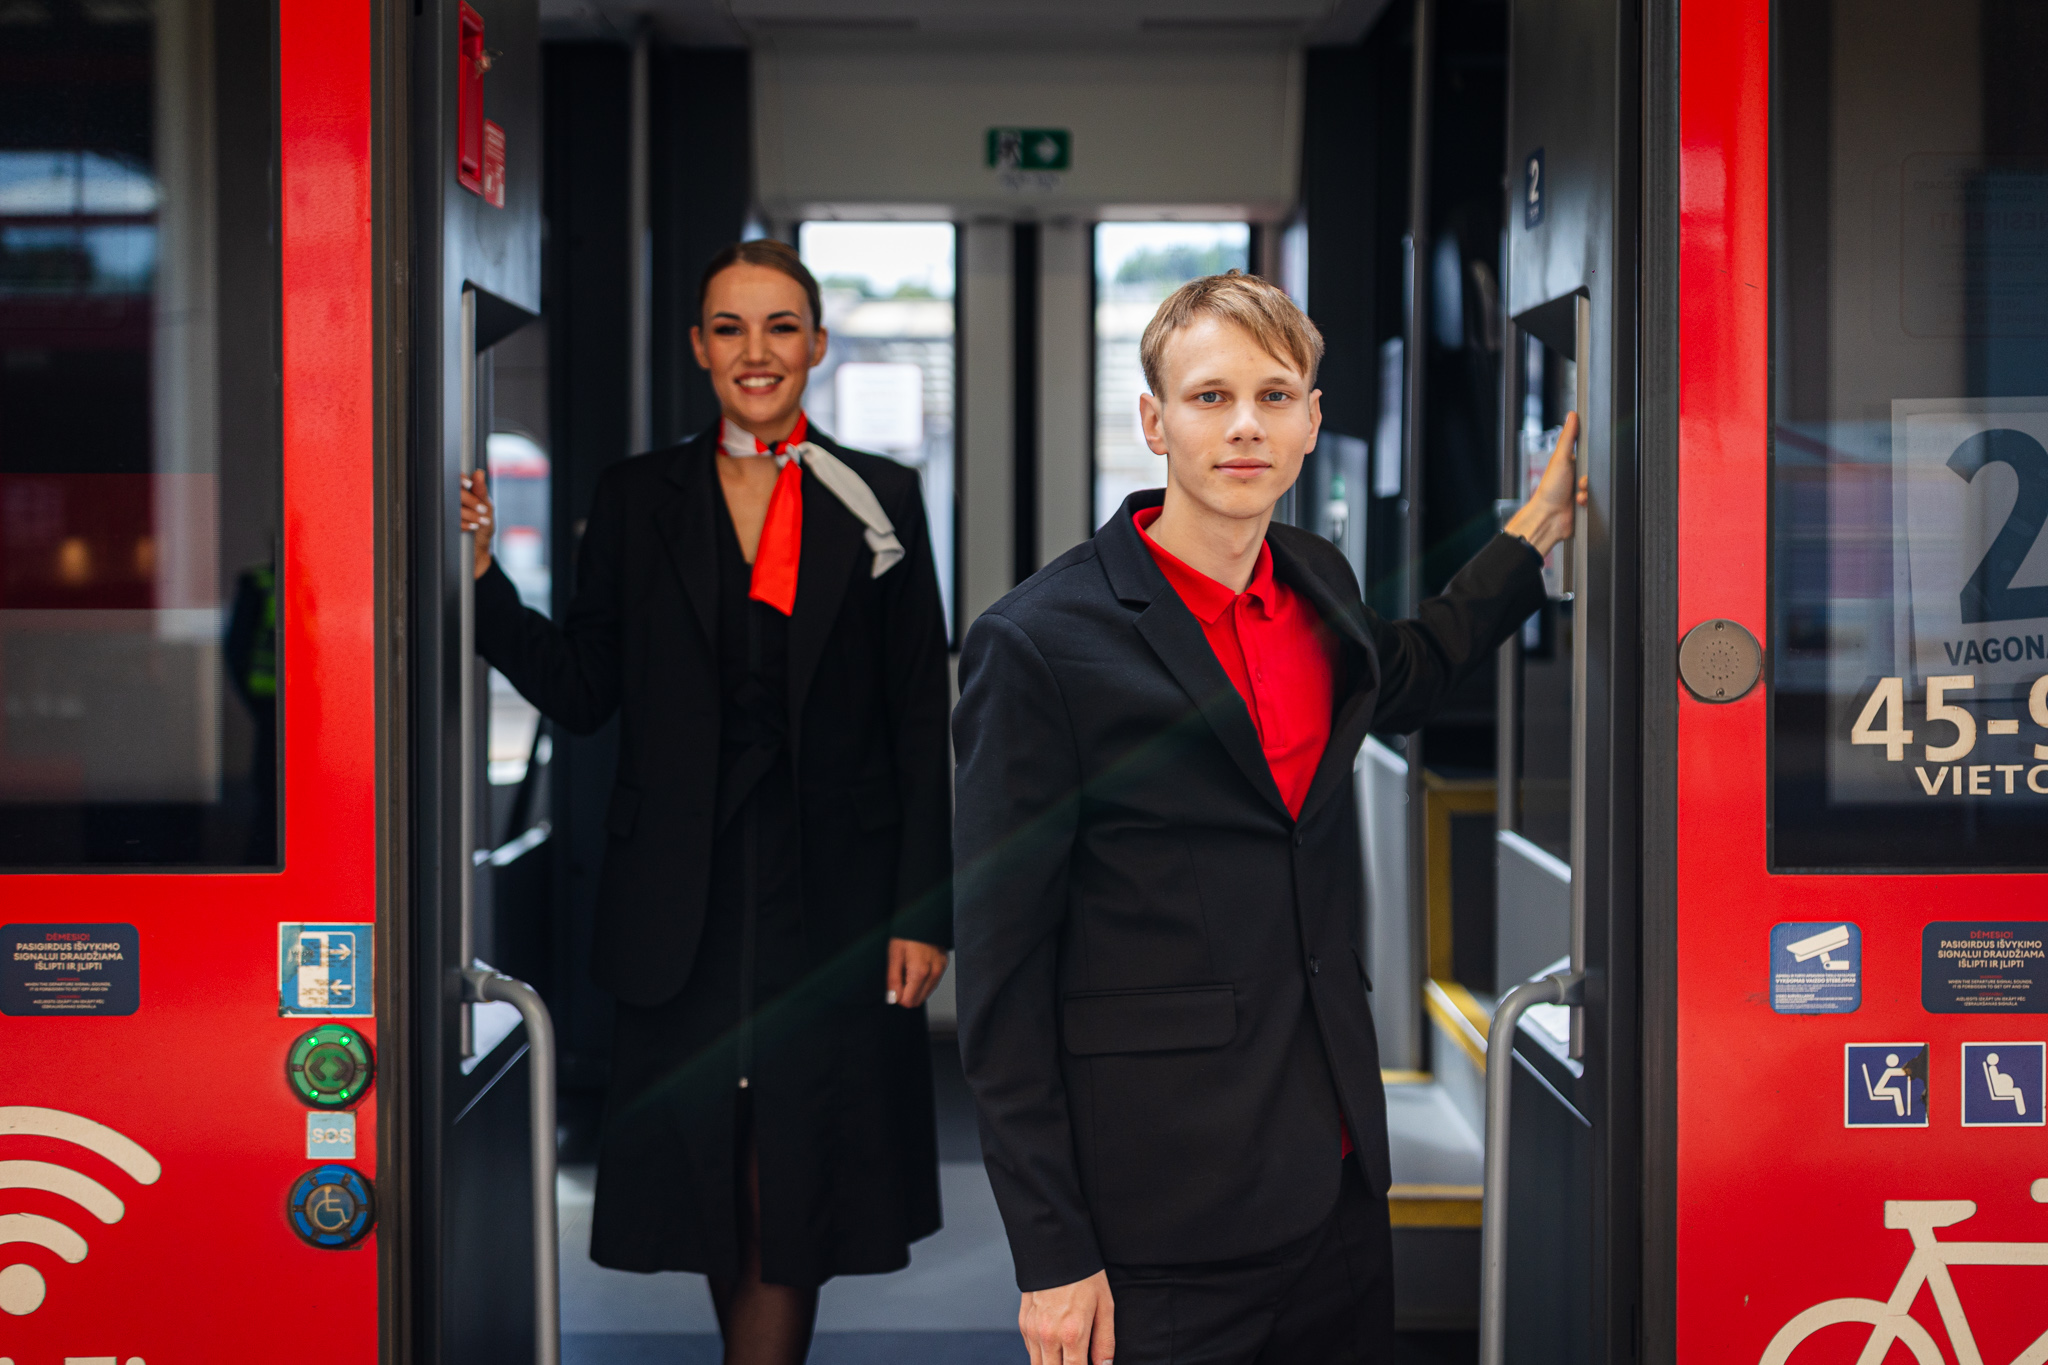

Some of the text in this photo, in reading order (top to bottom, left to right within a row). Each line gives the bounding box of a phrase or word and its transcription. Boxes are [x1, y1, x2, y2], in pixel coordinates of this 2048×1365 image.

[1529, 159, 1539, 204] 2
[1945, 428, 2048, 625] 2
[1943, 634, 2048, 667] VAGON
[16, 941, 120, 951] PASIGIRDUS IŠVYKIMO
[1941, 939, 2042, 949] PASIGIRDUS IŠVYKIMO
[13, 951, 123, 961] SIGNALUI DRAUDŽIAMA
[1938, 949, 2045, 958] SIGNALUI DRAUDŽIAMA
[34, 961, 64, 970] IŠLIPTI
[66, 962, 76, 970] IR
[1958, 958, 2024, 970] IŠLIPTI IR ĮLIPTI
[312, 1128, 352, 1144] SOS
